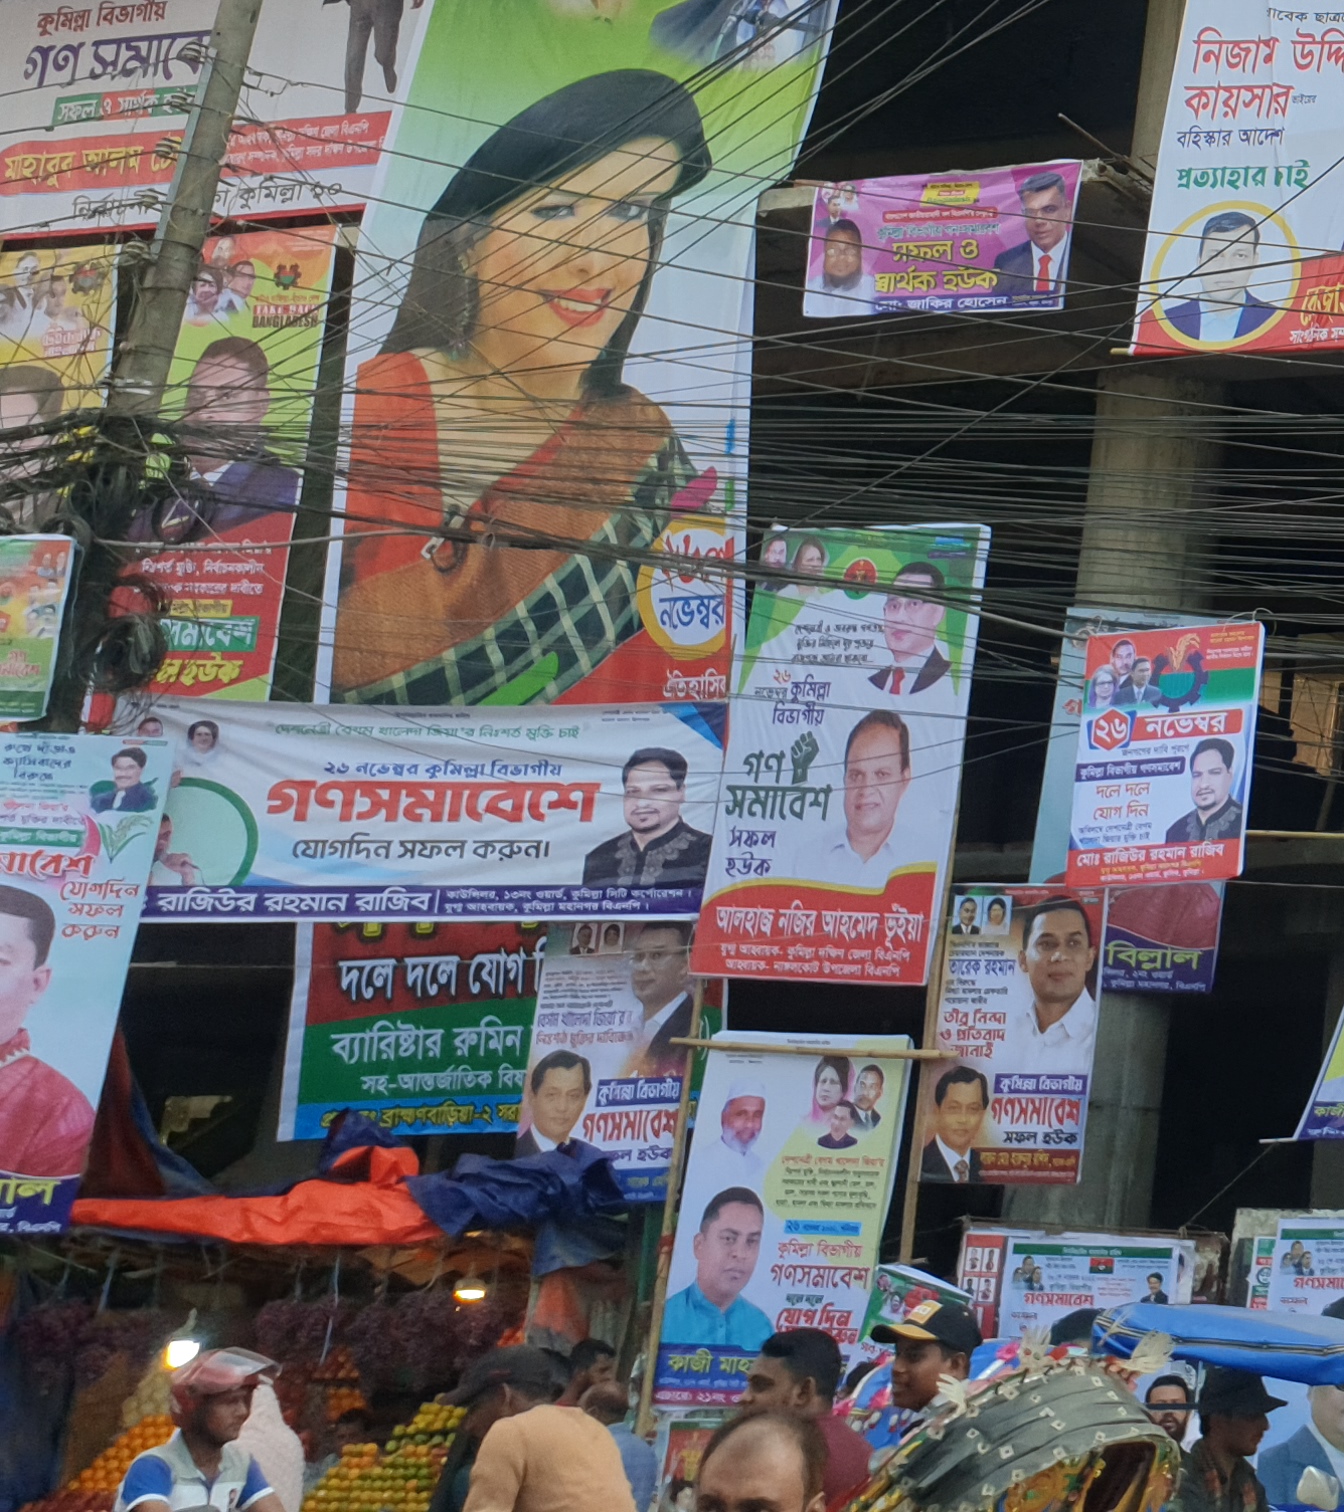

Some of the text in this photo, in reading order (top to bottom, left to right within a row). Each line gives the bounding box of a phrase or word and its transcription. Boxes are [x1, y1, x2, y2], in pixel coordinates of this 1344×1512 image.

[1094, 710, 1226, 749] ২৬ নভেম্বর
[743, 749, 785, 786] গণ
[267, 778, 601, 825] গণসমাবেশে
[725, 782, 834, 822] সমাবেশ
[291, 837, 392, 864] যোগদিন
[398, 840, 465, 861] সফল
[157, 887, 432, 915] রাজিউর রহমান রাজিব
